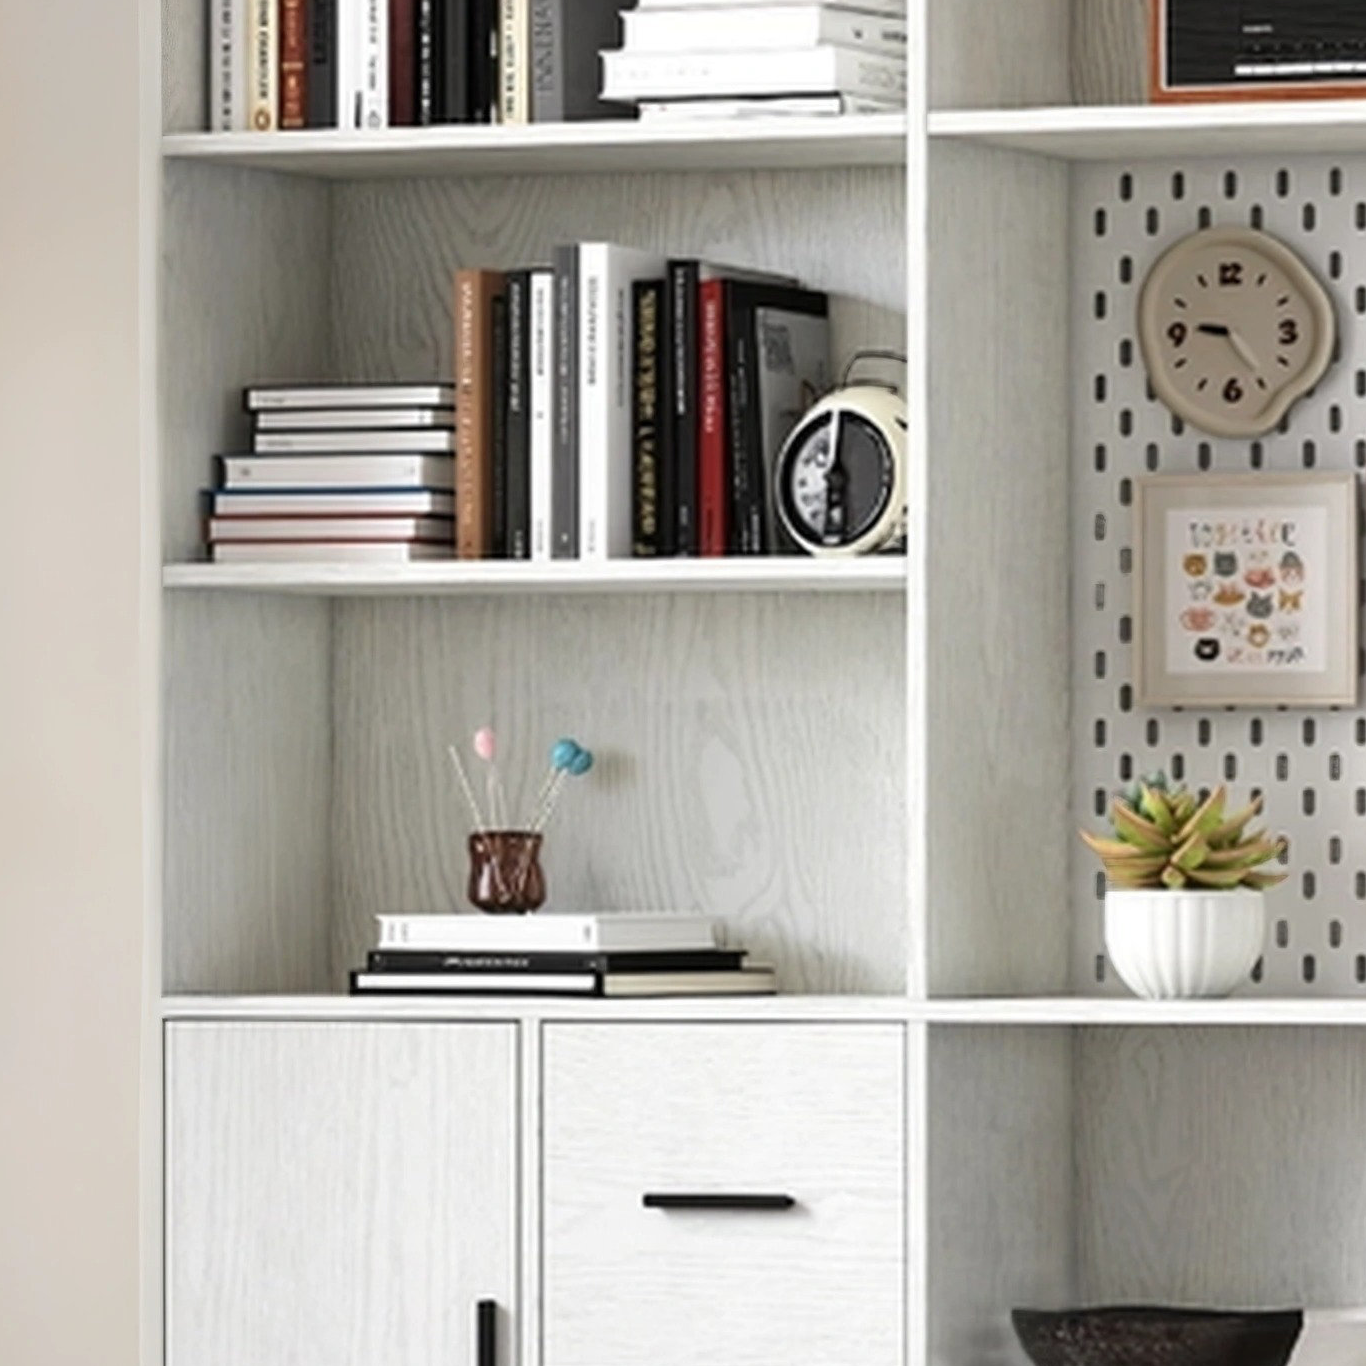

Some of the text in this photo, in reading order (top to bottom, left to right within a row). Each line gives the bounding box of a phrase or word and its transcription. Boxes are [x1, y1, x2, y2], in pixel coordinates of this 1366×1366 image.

[1219, 262, 1243, 286] 12
[1167, 321, 1187, 347] 9
[1278, 319, 1299, 344] 3
[1222, 377, 1243, 403] 6
